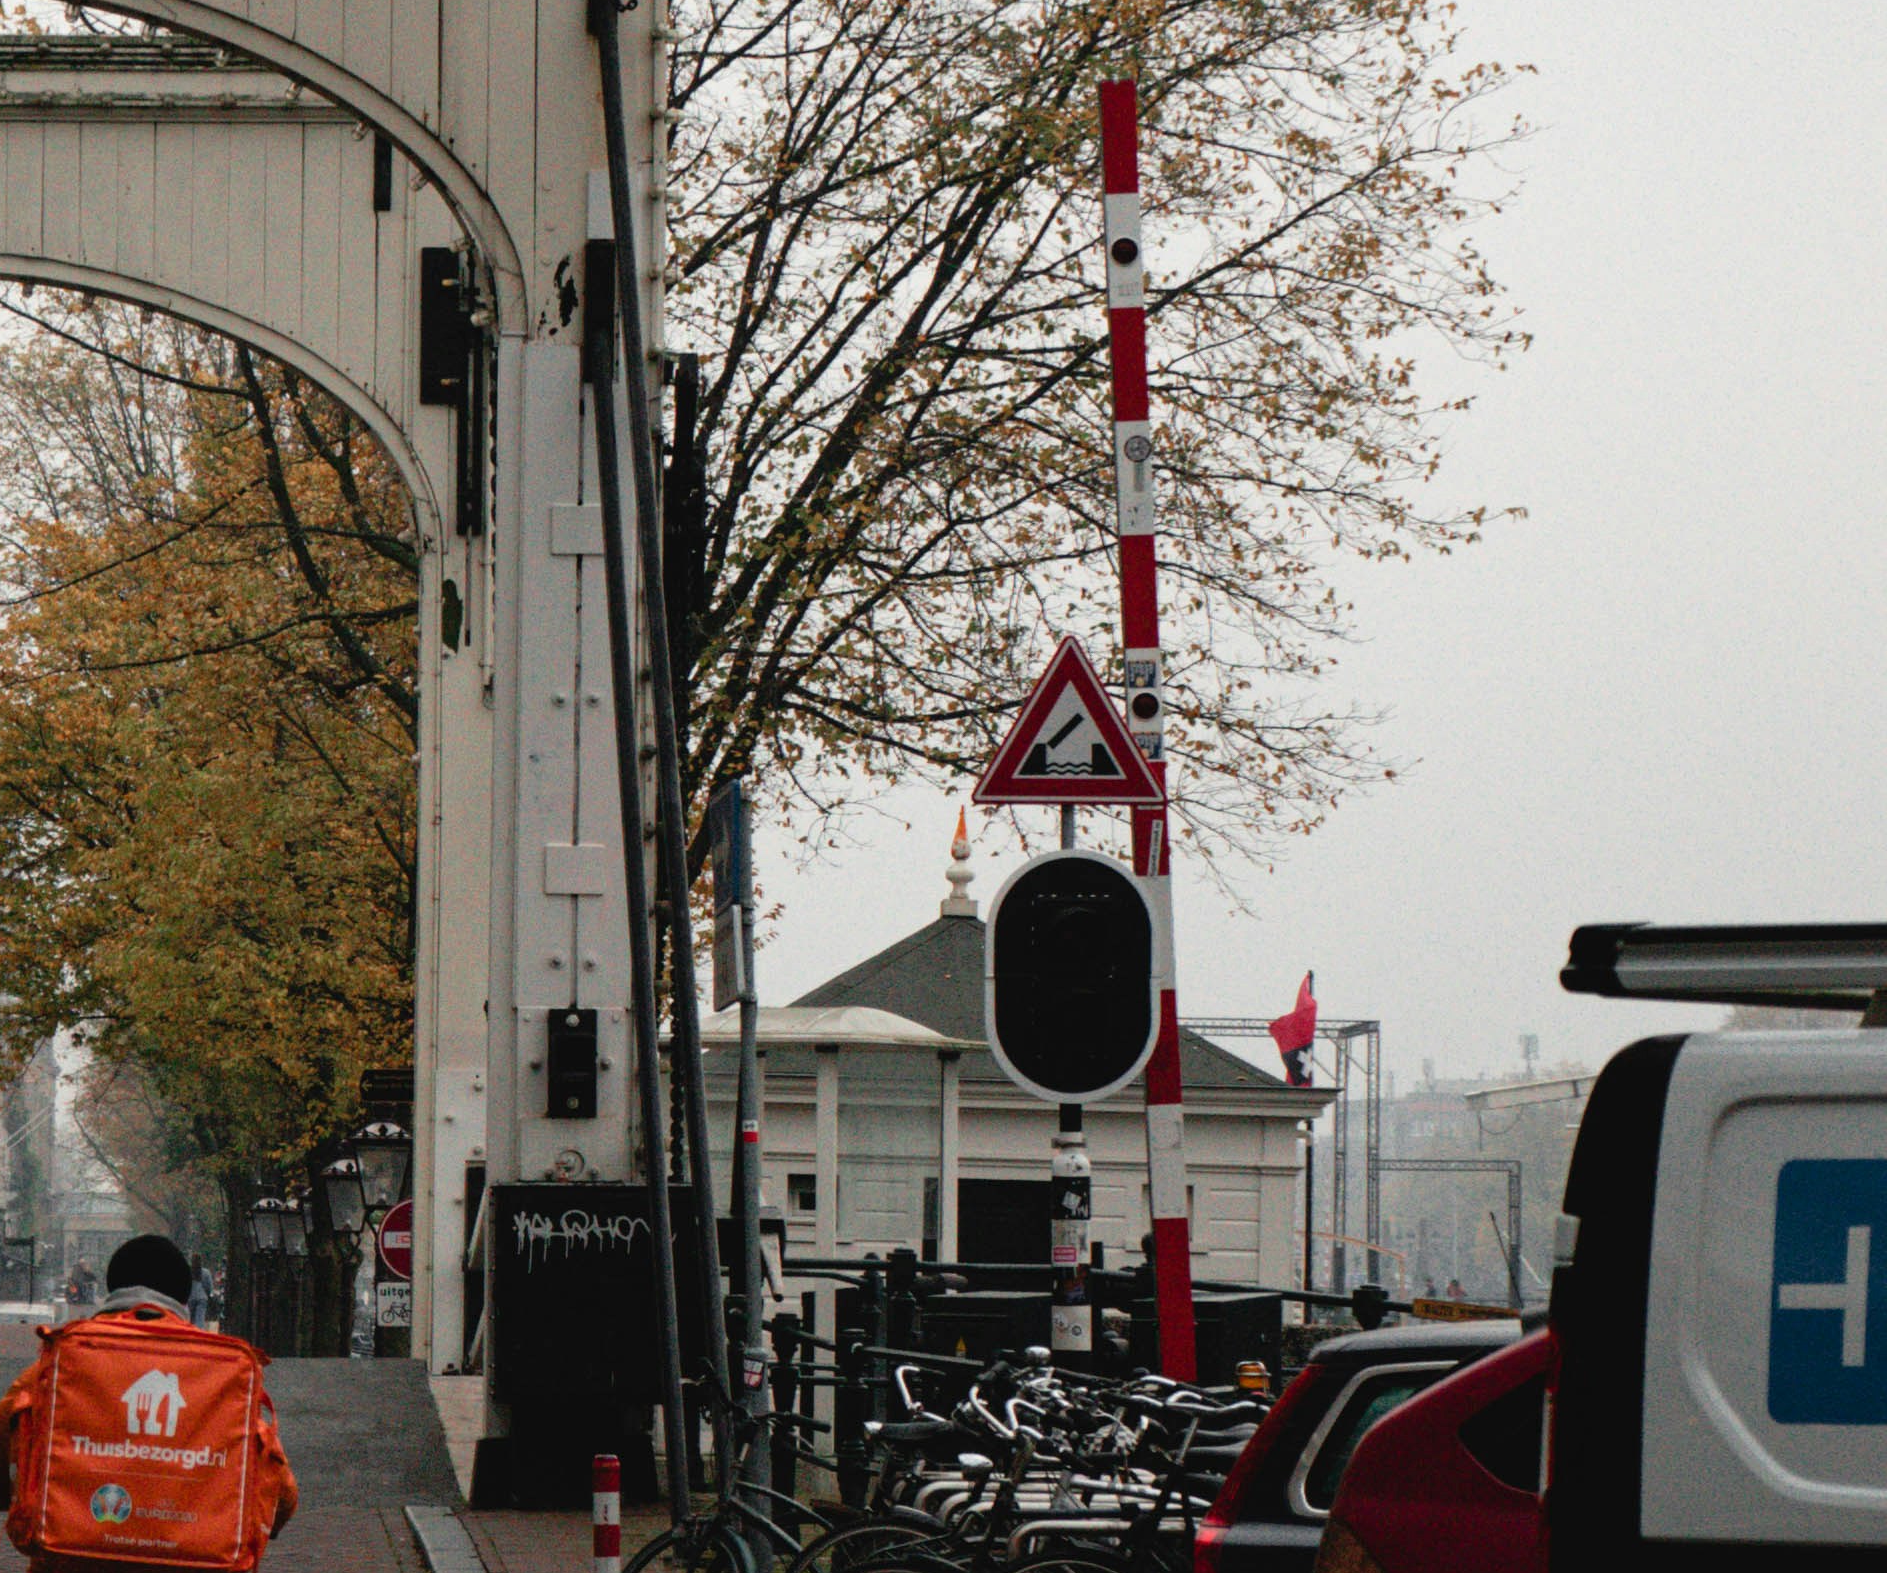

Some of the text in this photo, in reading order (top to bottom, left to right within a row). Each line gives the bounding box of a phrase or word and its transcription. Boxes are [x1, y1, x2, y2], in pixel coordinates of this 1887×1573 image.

[71, 1436, 227, 1469] Thuisbezorgd.nl
[104, 1533, 178, 1549] Trotse partner
